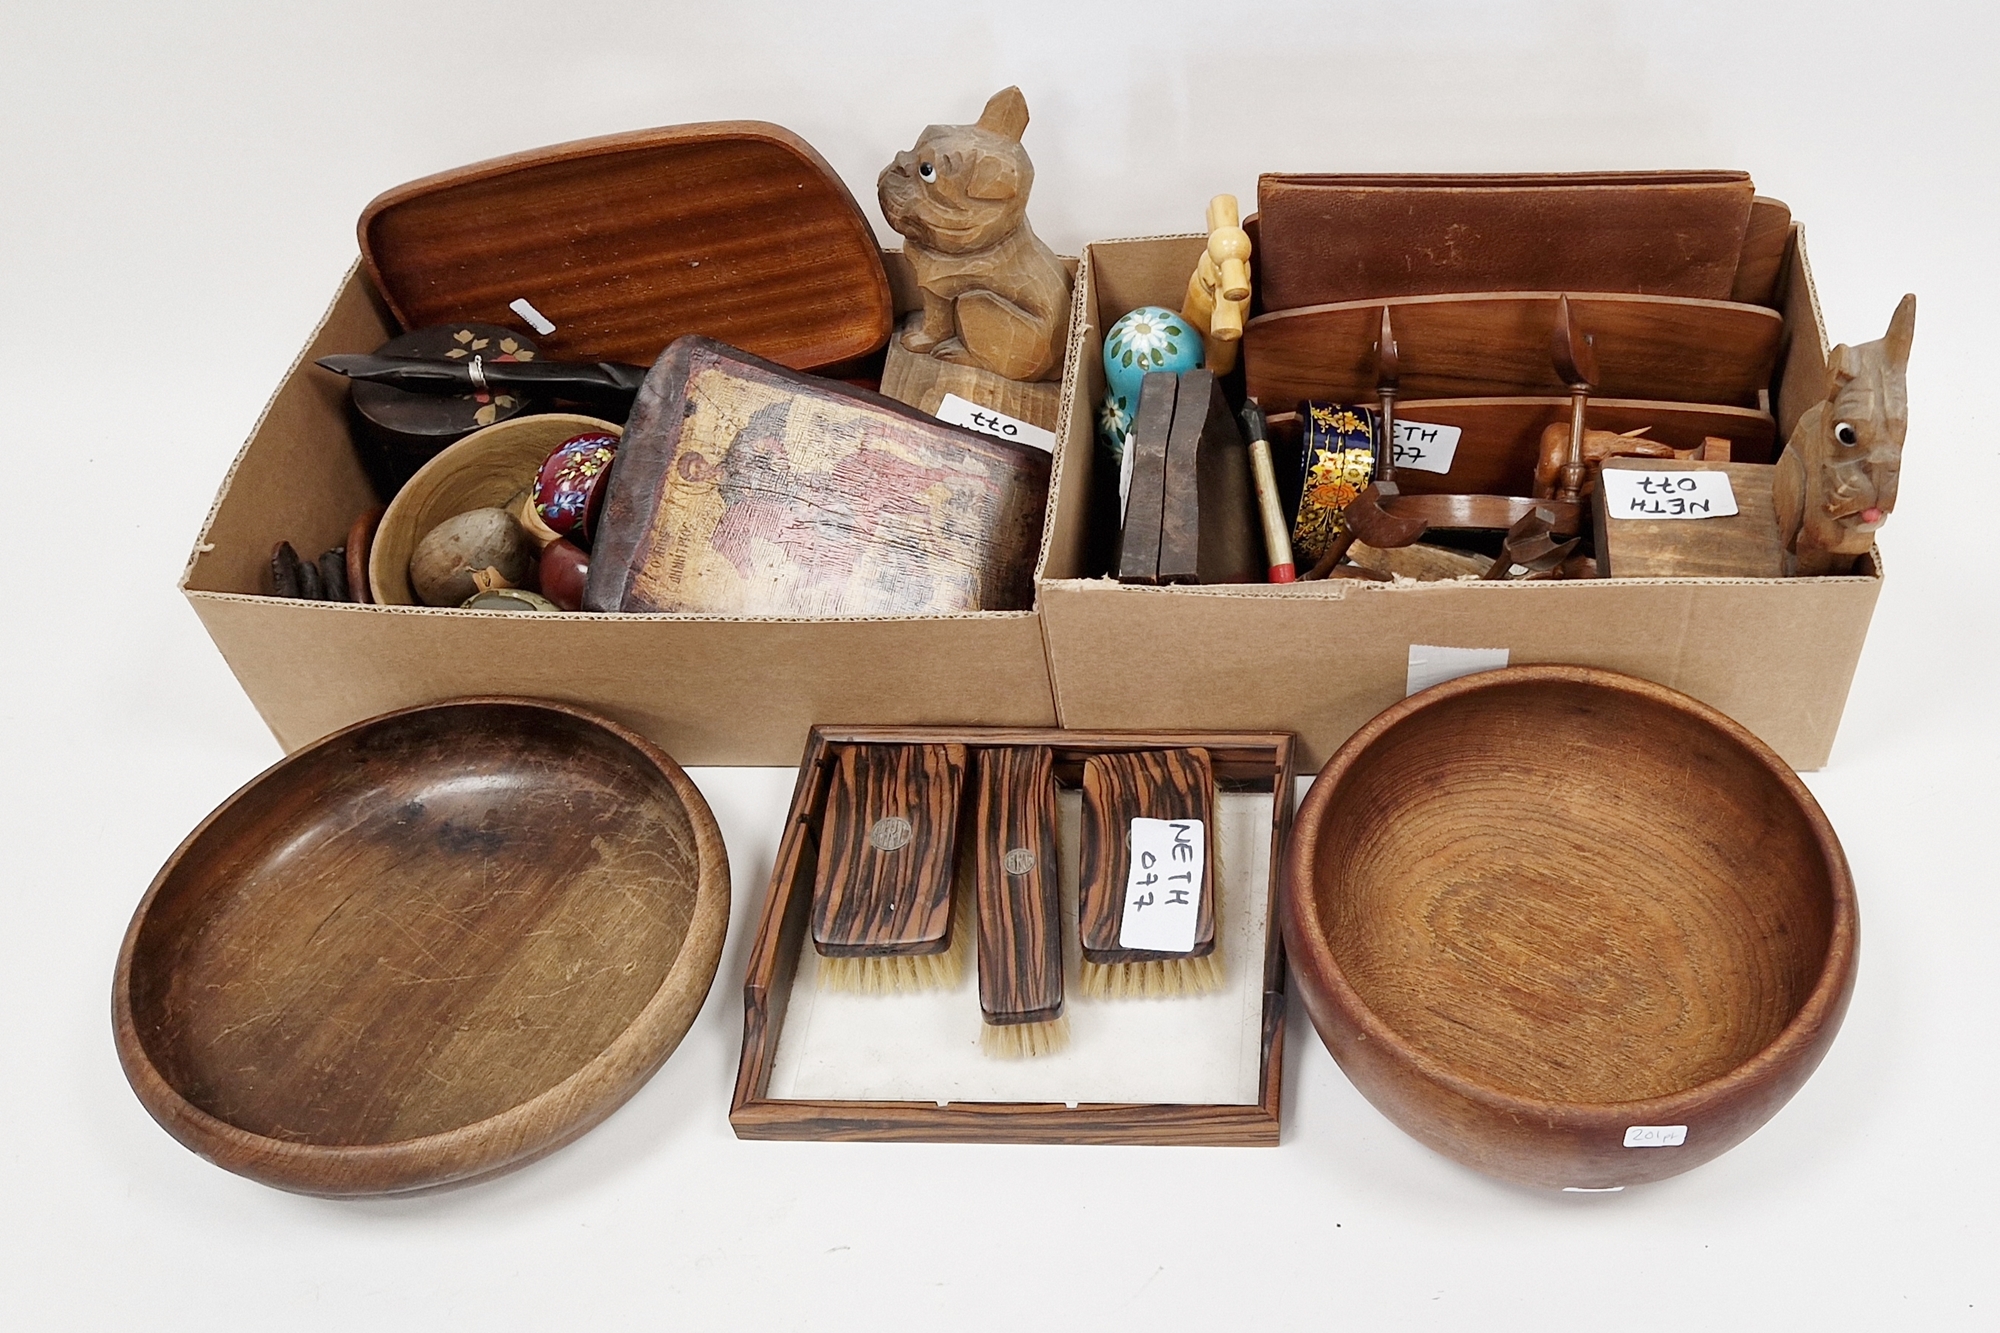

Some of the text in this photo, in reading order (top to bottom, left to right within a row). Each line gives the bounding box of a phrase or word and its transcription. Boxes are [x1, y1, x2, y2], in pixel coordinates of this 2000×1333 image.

[970, 412, 1018, 436] 077
[1636, 476, 1697, 494] 077
[1630, 497, 1710, 515] NETH
[1164, 823, 1193, 905] NETH
[1132, 851, 1159, 912] 077
